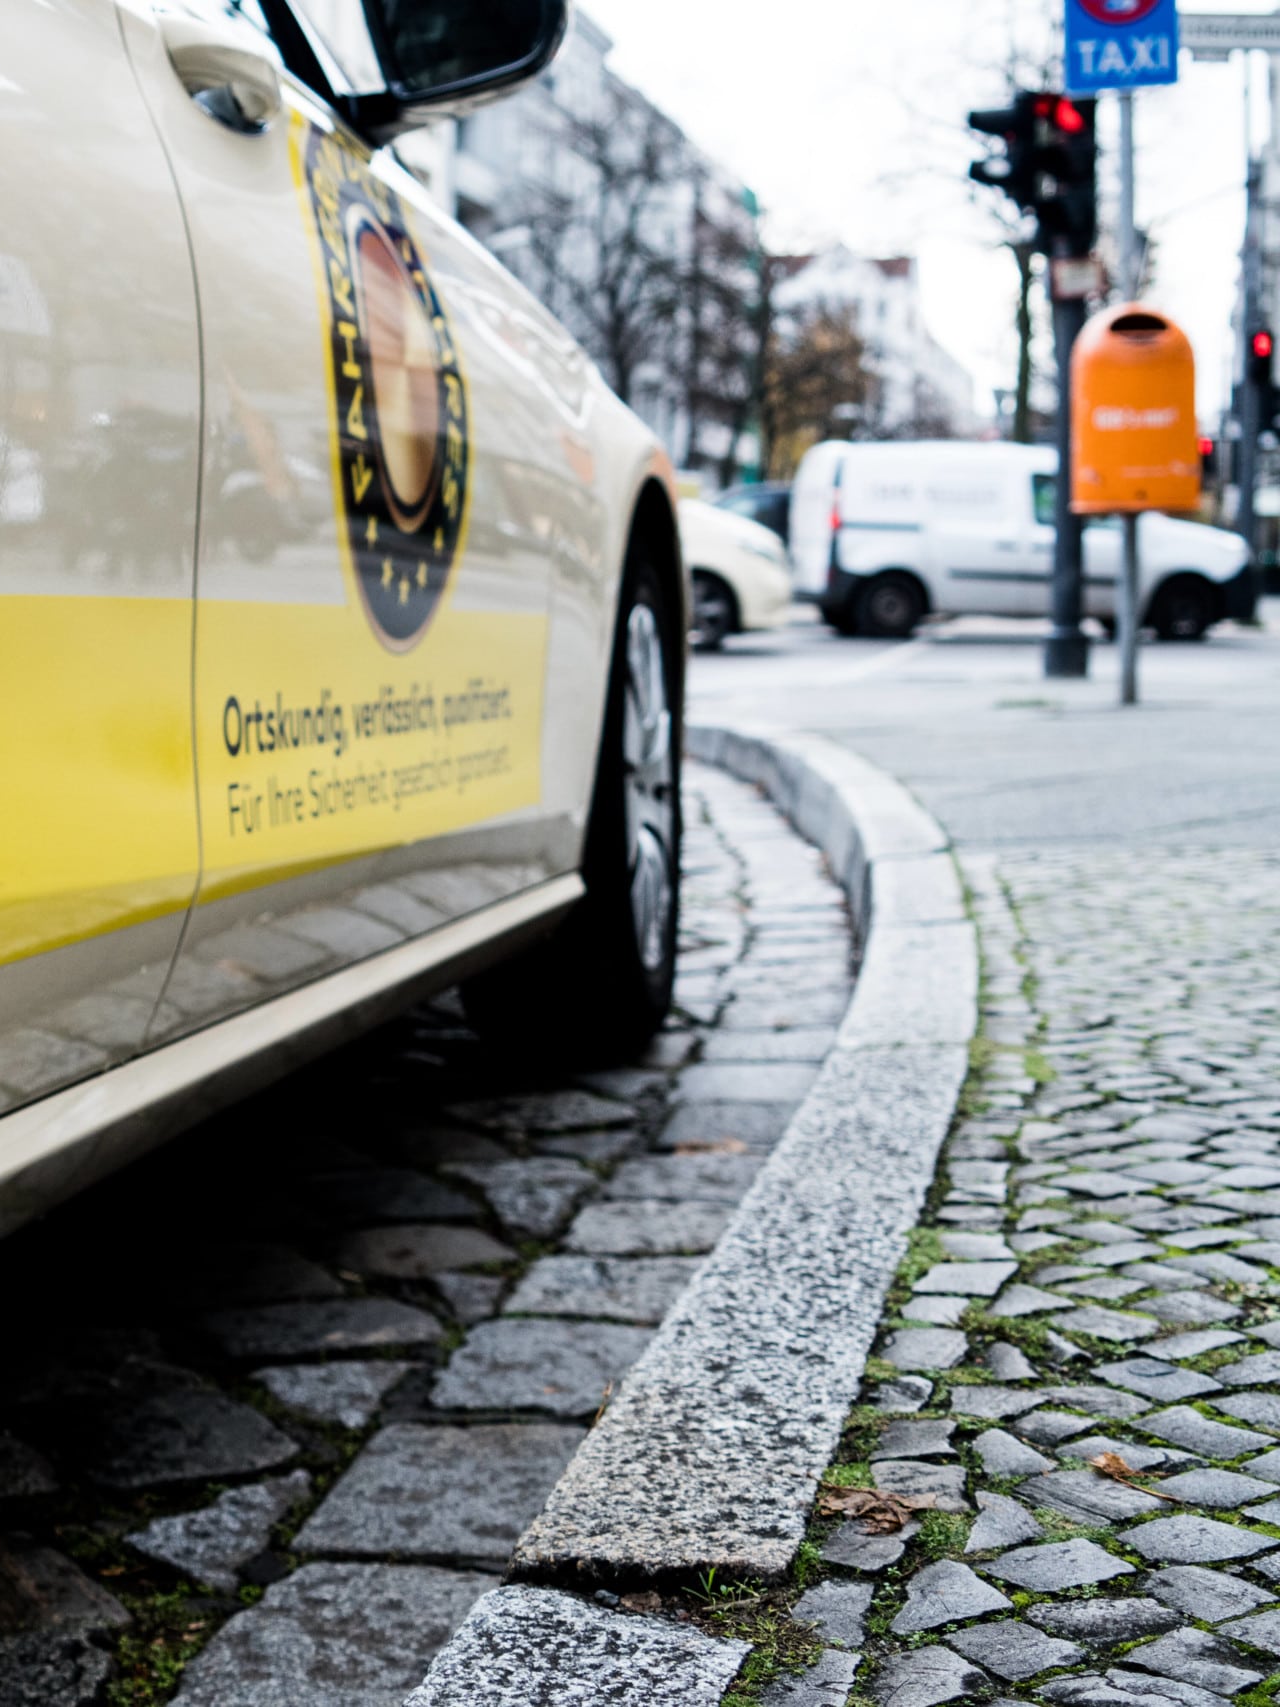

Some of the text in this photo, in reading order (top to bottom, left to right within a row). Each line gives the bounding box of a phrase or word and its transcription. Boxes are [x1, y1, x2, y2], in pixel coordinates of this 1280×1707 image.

[1078, 37, 1169, 74] TAXI
[223, 688, 349, 757] Ortskundig,
[228, 783, 262, 837] Für
[267, 776, 303, 827] Ihre
